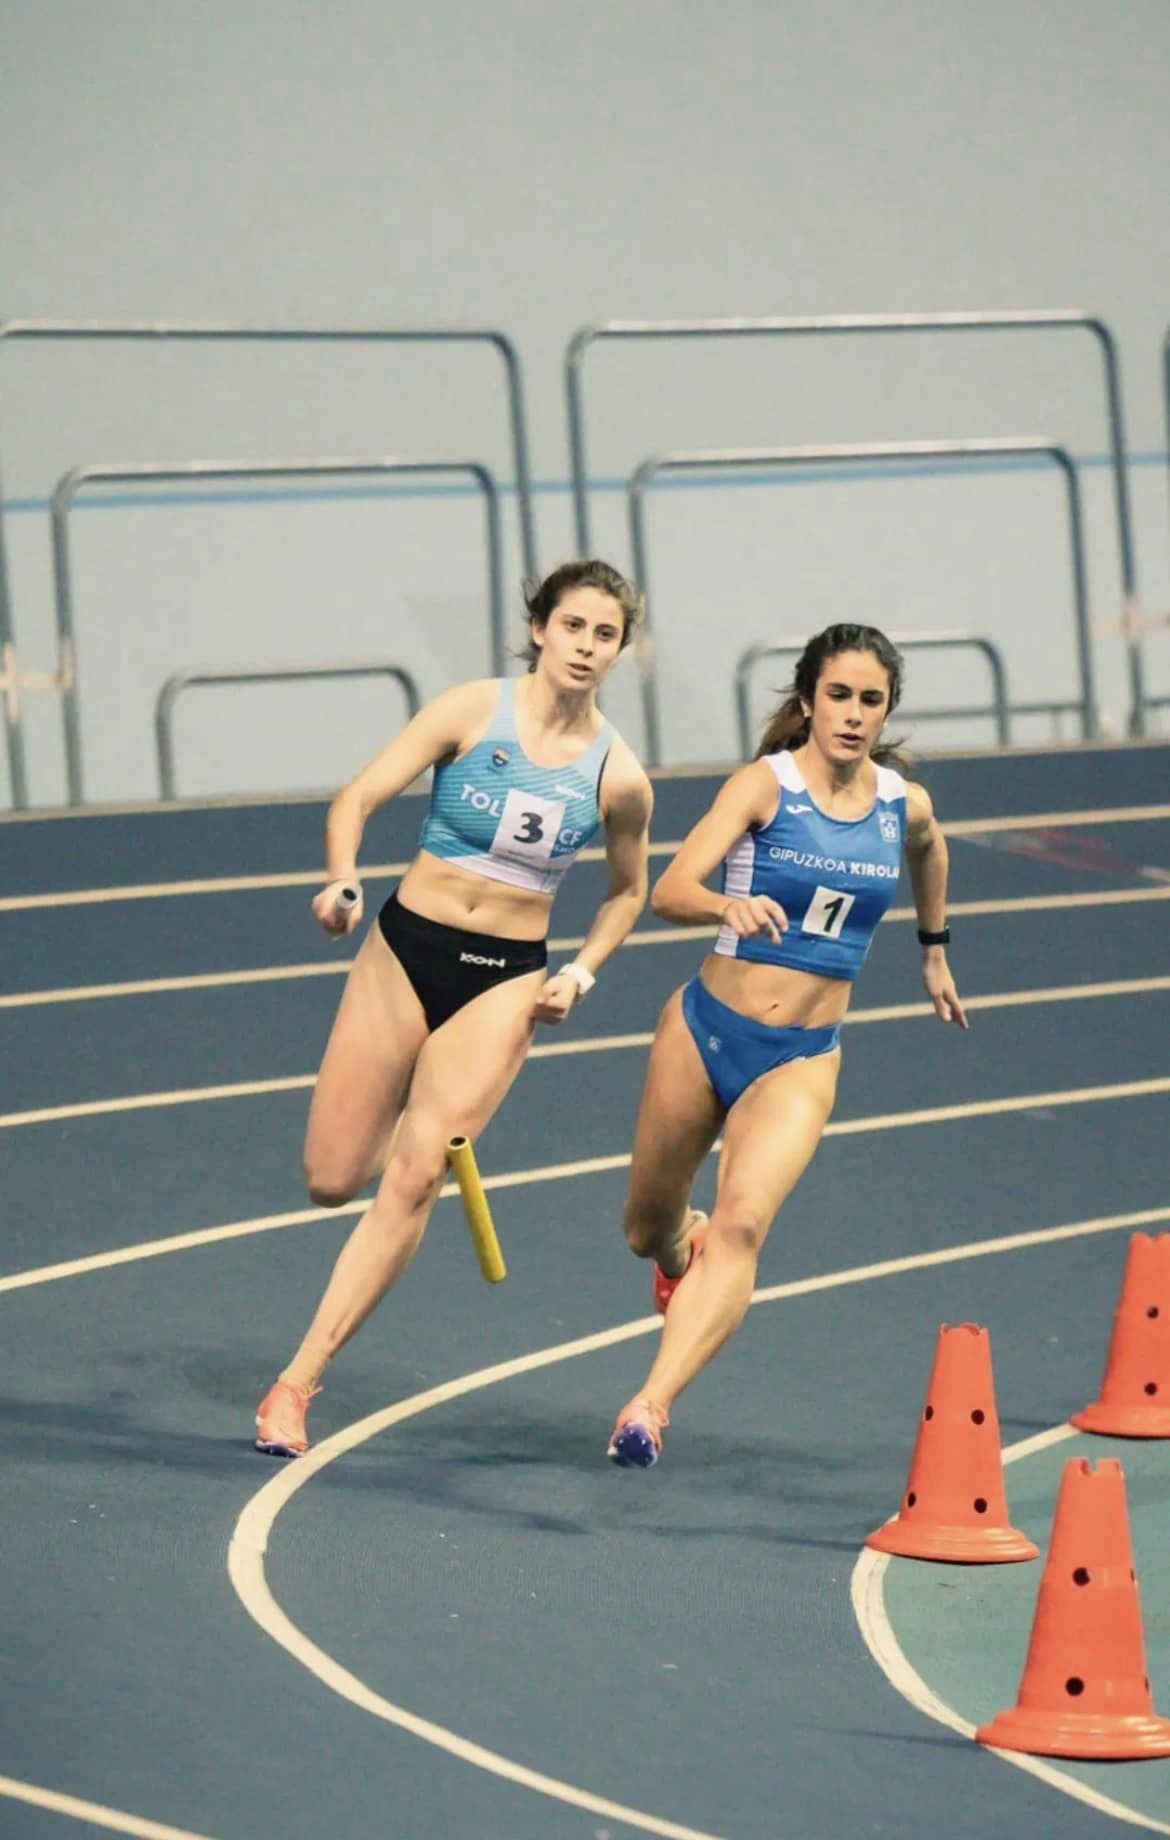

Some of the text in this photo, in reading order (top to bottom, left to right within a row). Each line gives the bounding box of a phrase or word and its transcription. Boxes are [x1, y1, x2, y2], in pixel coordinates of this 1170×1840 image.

[513, 812, 544, 845] 3
[769, 847, 847, 873] GIPUZKOA
[823, 896, 845, 933] 1
